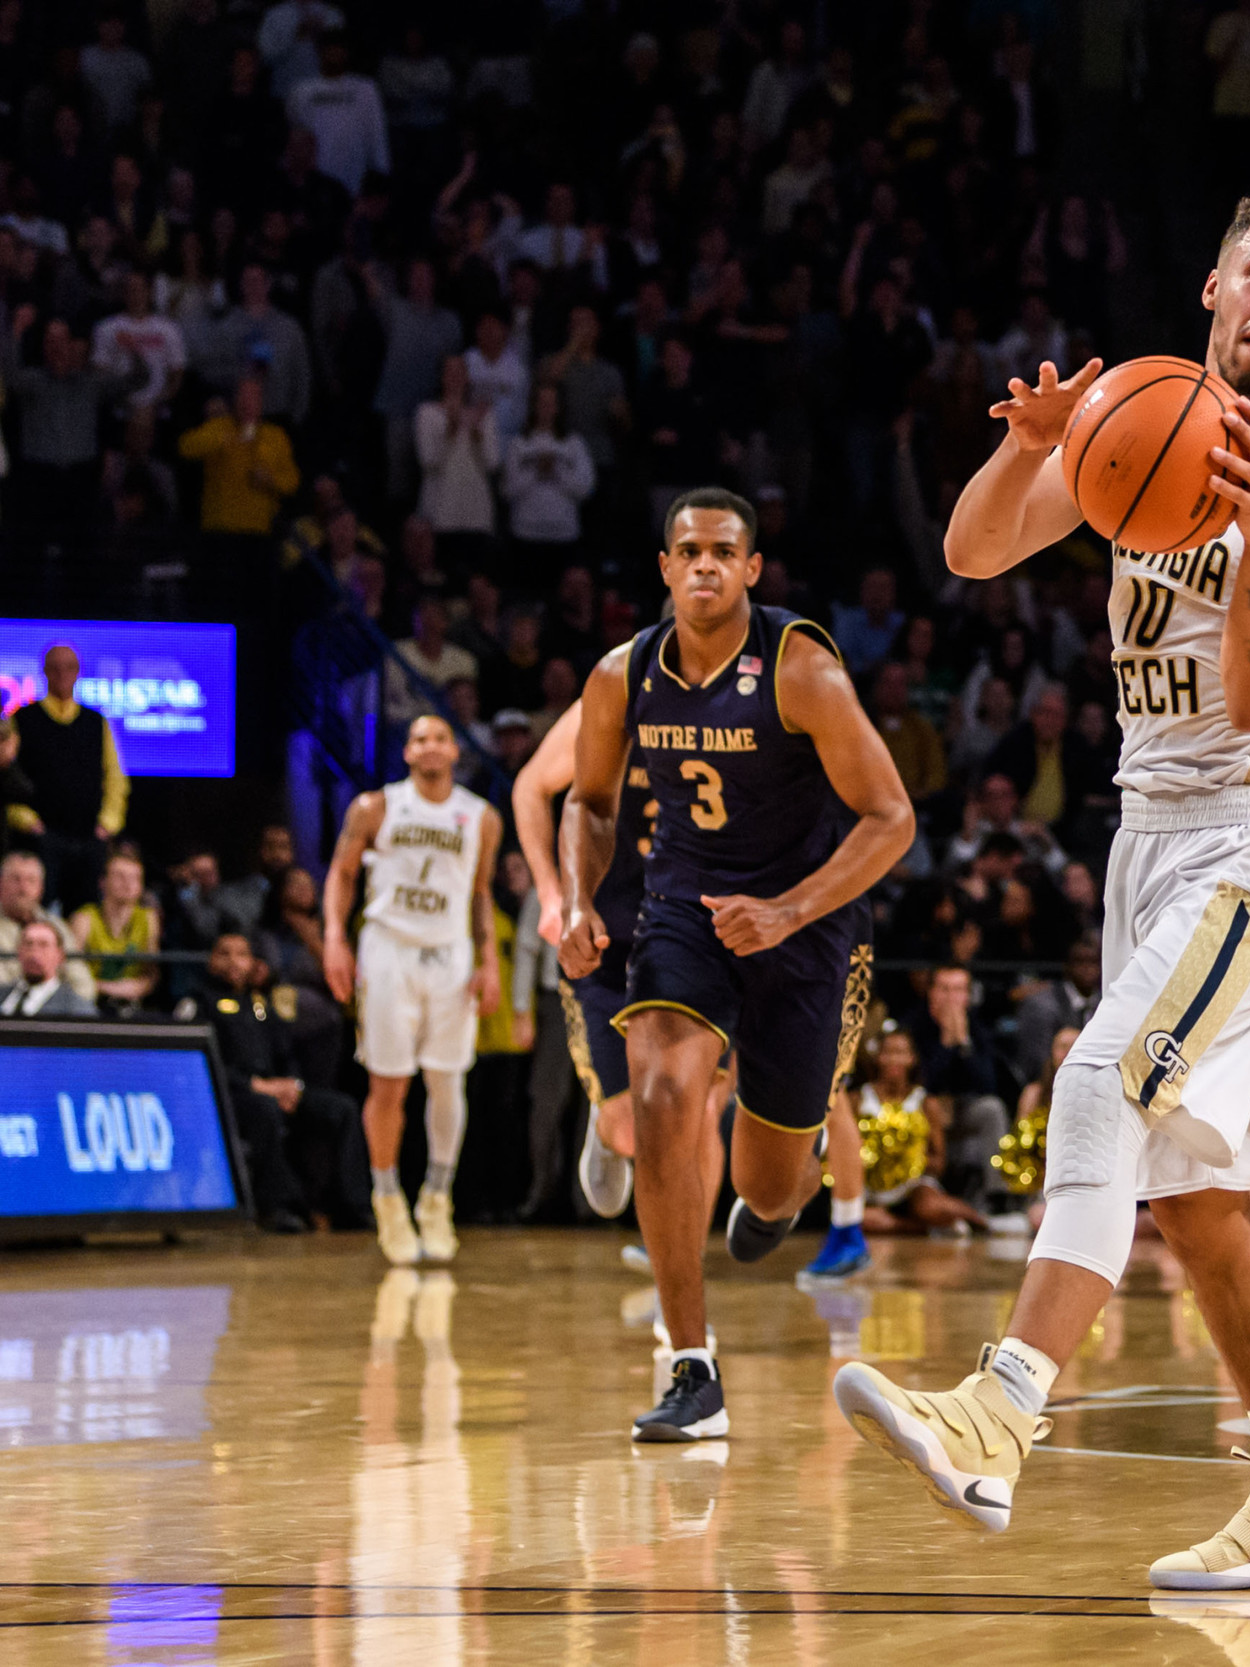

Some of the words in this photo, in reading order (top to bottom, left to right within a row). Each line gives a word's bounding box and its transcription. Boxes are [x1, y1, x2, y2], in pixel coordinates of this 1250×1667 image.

[1122, 577, 1175, 648] 10
[1112, 656, 1200, 716] ECH
[638, 724, 697, 750] NOTRE
[702, 727, 758, 752] DAME
[679, 759, 728, 831] 3
[57, 1092, 174, 1172] LOUD
